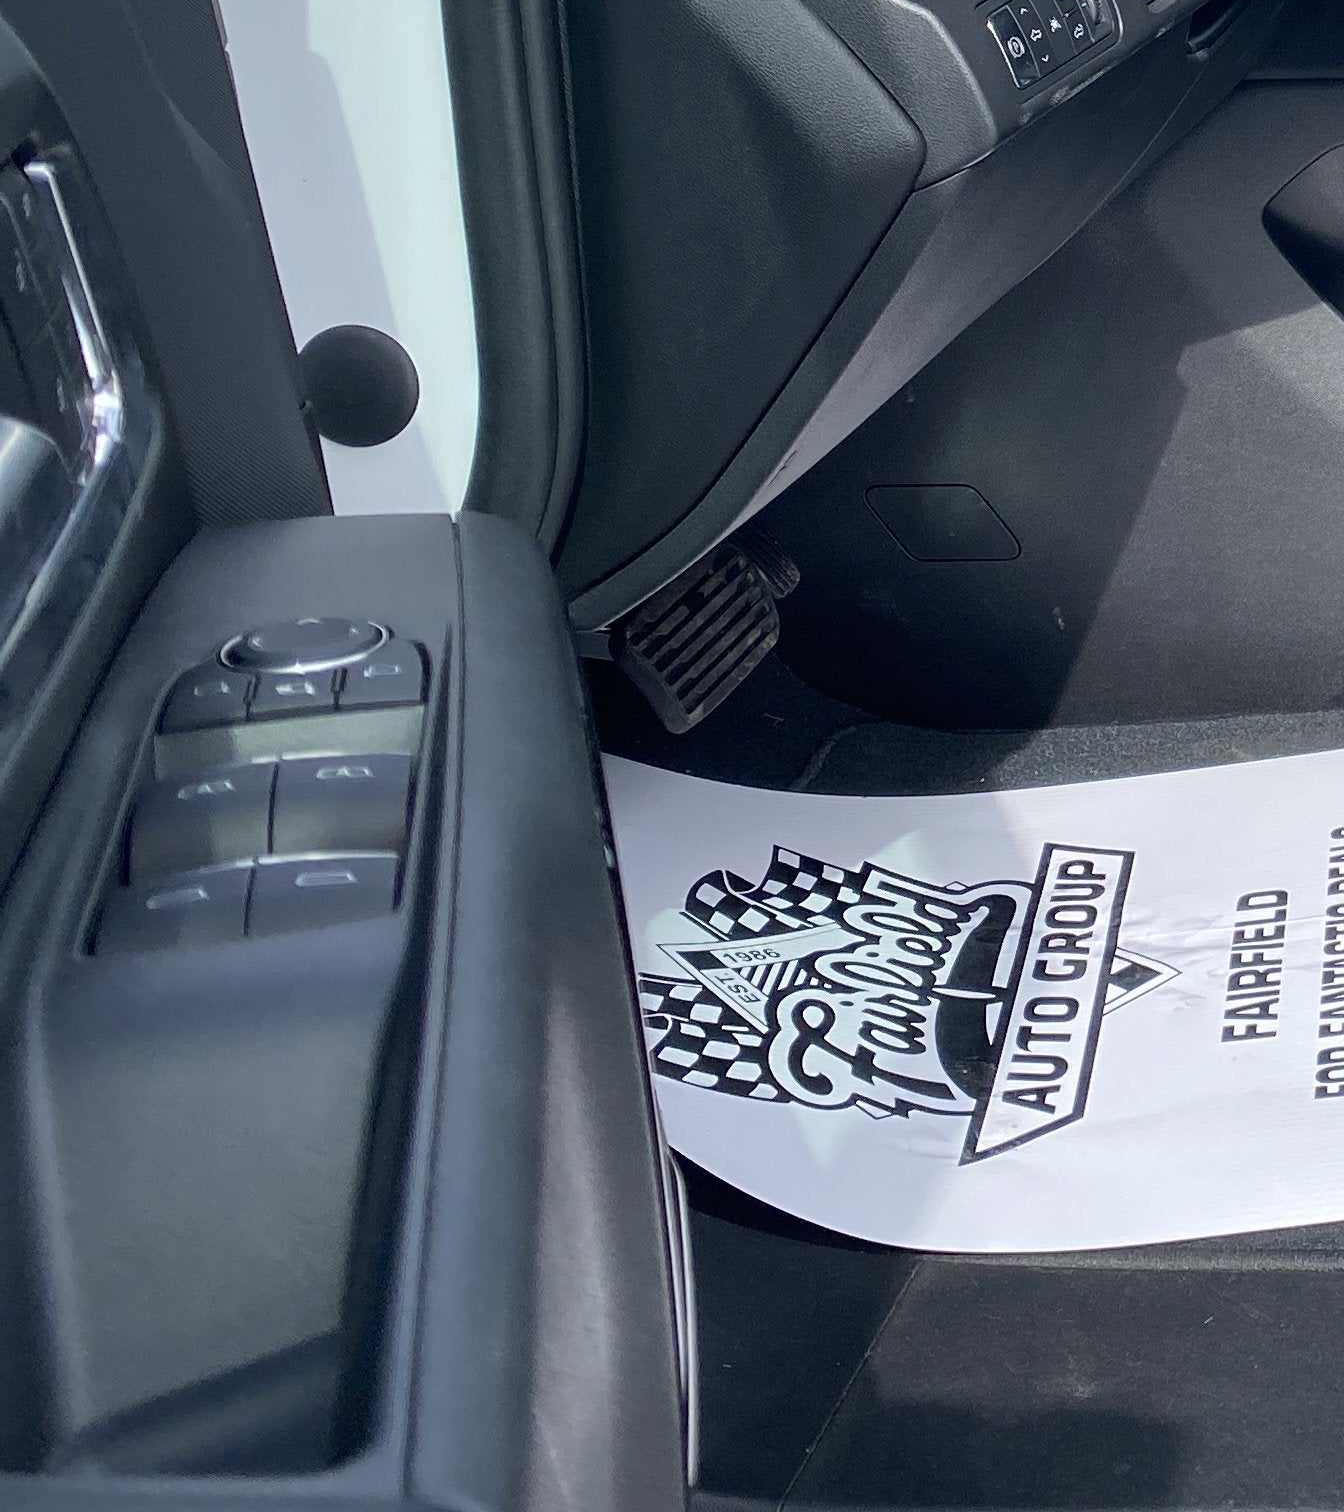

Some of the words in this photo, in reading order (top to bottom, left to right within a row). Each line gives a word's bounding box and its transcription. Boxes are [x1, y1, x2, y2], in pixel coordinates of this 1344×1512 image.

[722, 947, 781, 965] 1986
[1032, 858, 1106, 982] GROUP
[1221, 889, 1288, 1043] FAIRFIELD
[717, 970, 762, 1004] EST.
[787, 881, 968, 1100] Fairfield
[1002, 995, 1080, 1114] AUTO
